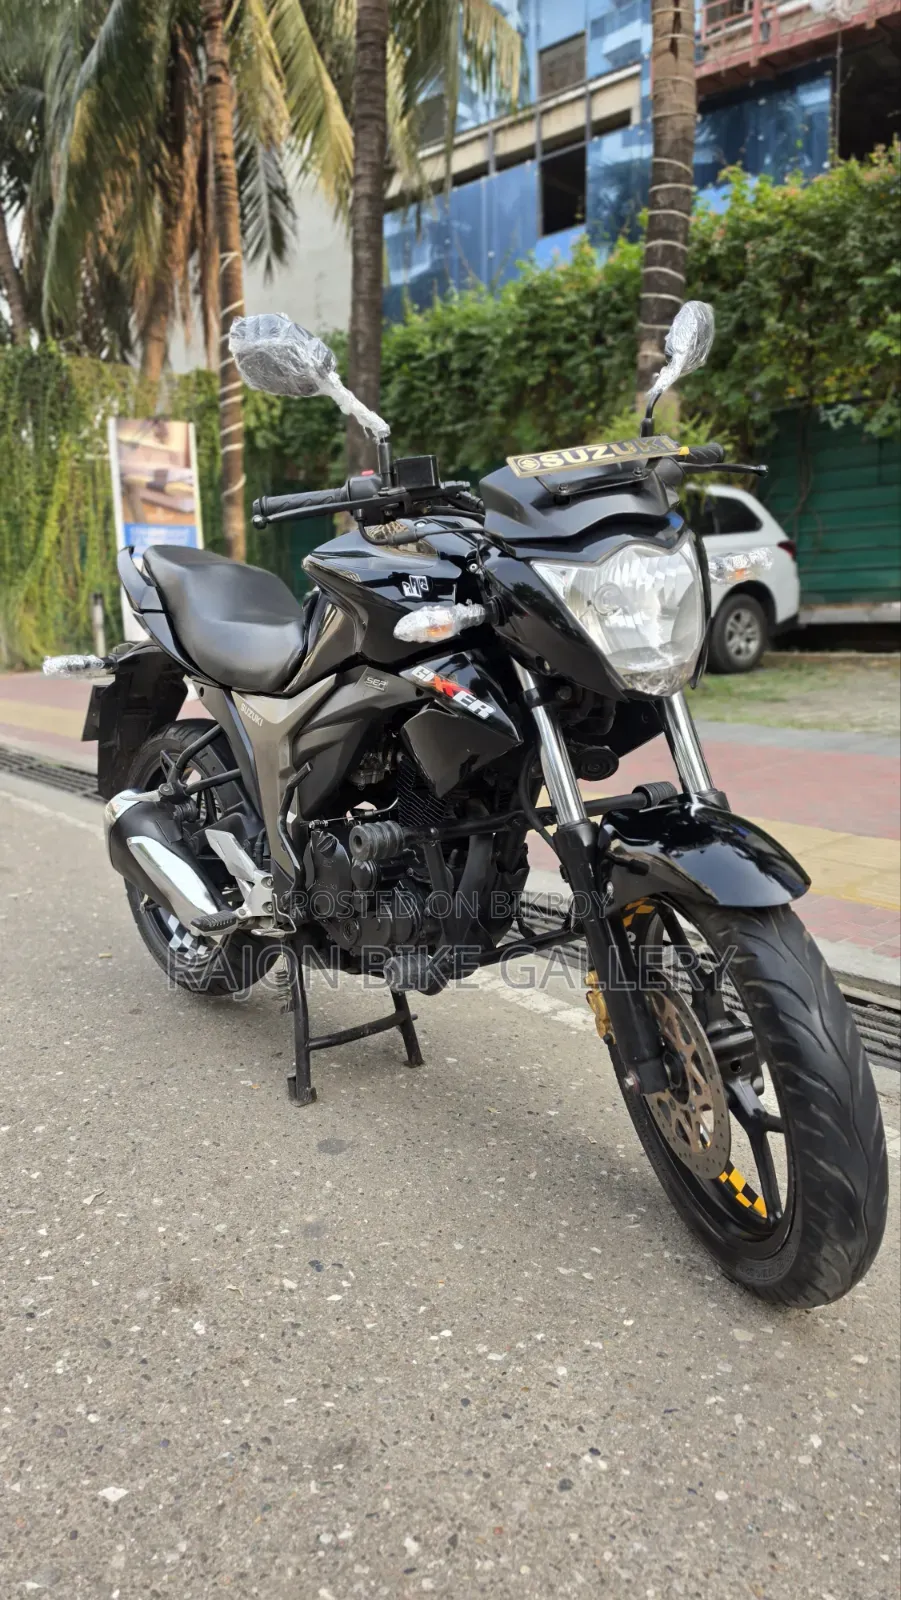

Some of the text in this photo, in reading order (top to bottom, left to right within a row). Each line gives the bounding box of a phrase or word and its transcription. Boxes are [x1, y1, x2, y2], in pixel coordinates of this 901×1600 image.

[539, 438, 676, 467] SUZUKI
[411, 665, 496, 720] GIXXER
[241, 703, 263, 726] SUZUKI
